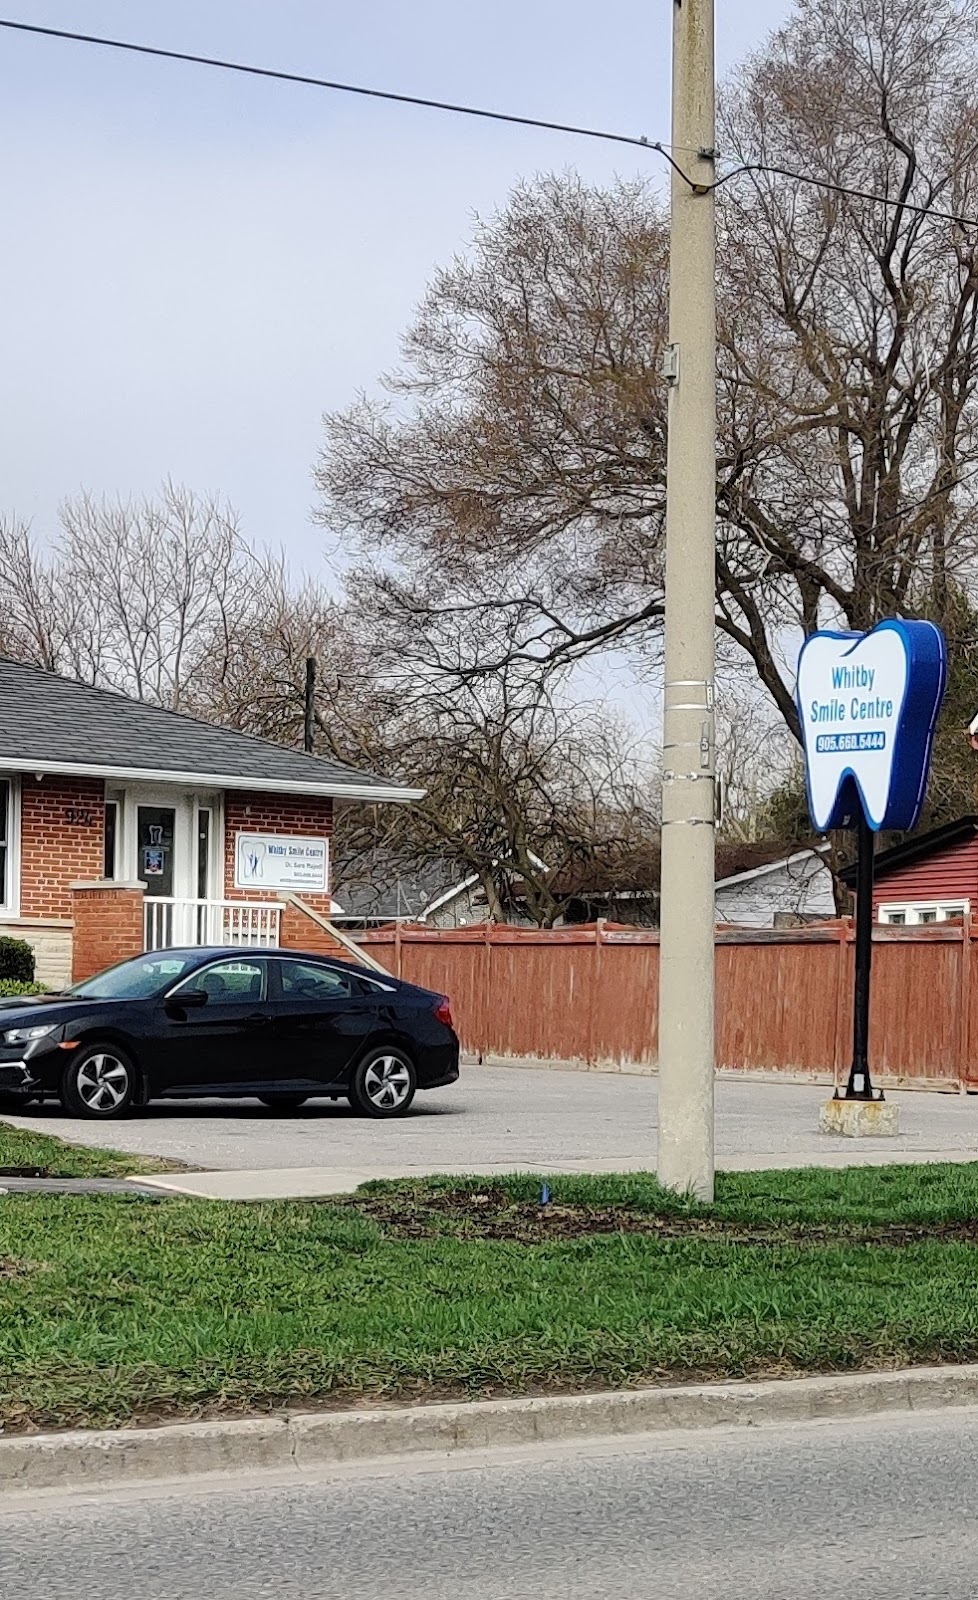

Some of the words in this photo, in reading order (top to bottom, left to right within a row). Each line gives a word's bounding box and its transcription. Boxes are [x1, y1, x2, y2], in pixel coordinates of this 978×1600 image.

[831, 664, 876, 692] Whitby
[810, 698, 846, 723] Smile
[850, 696, 893, 720] Centre
[268, 844, 287, 856] Whitby
[288, 845, 304, 855] Smile
[305, 846, 323, 858] Centre
